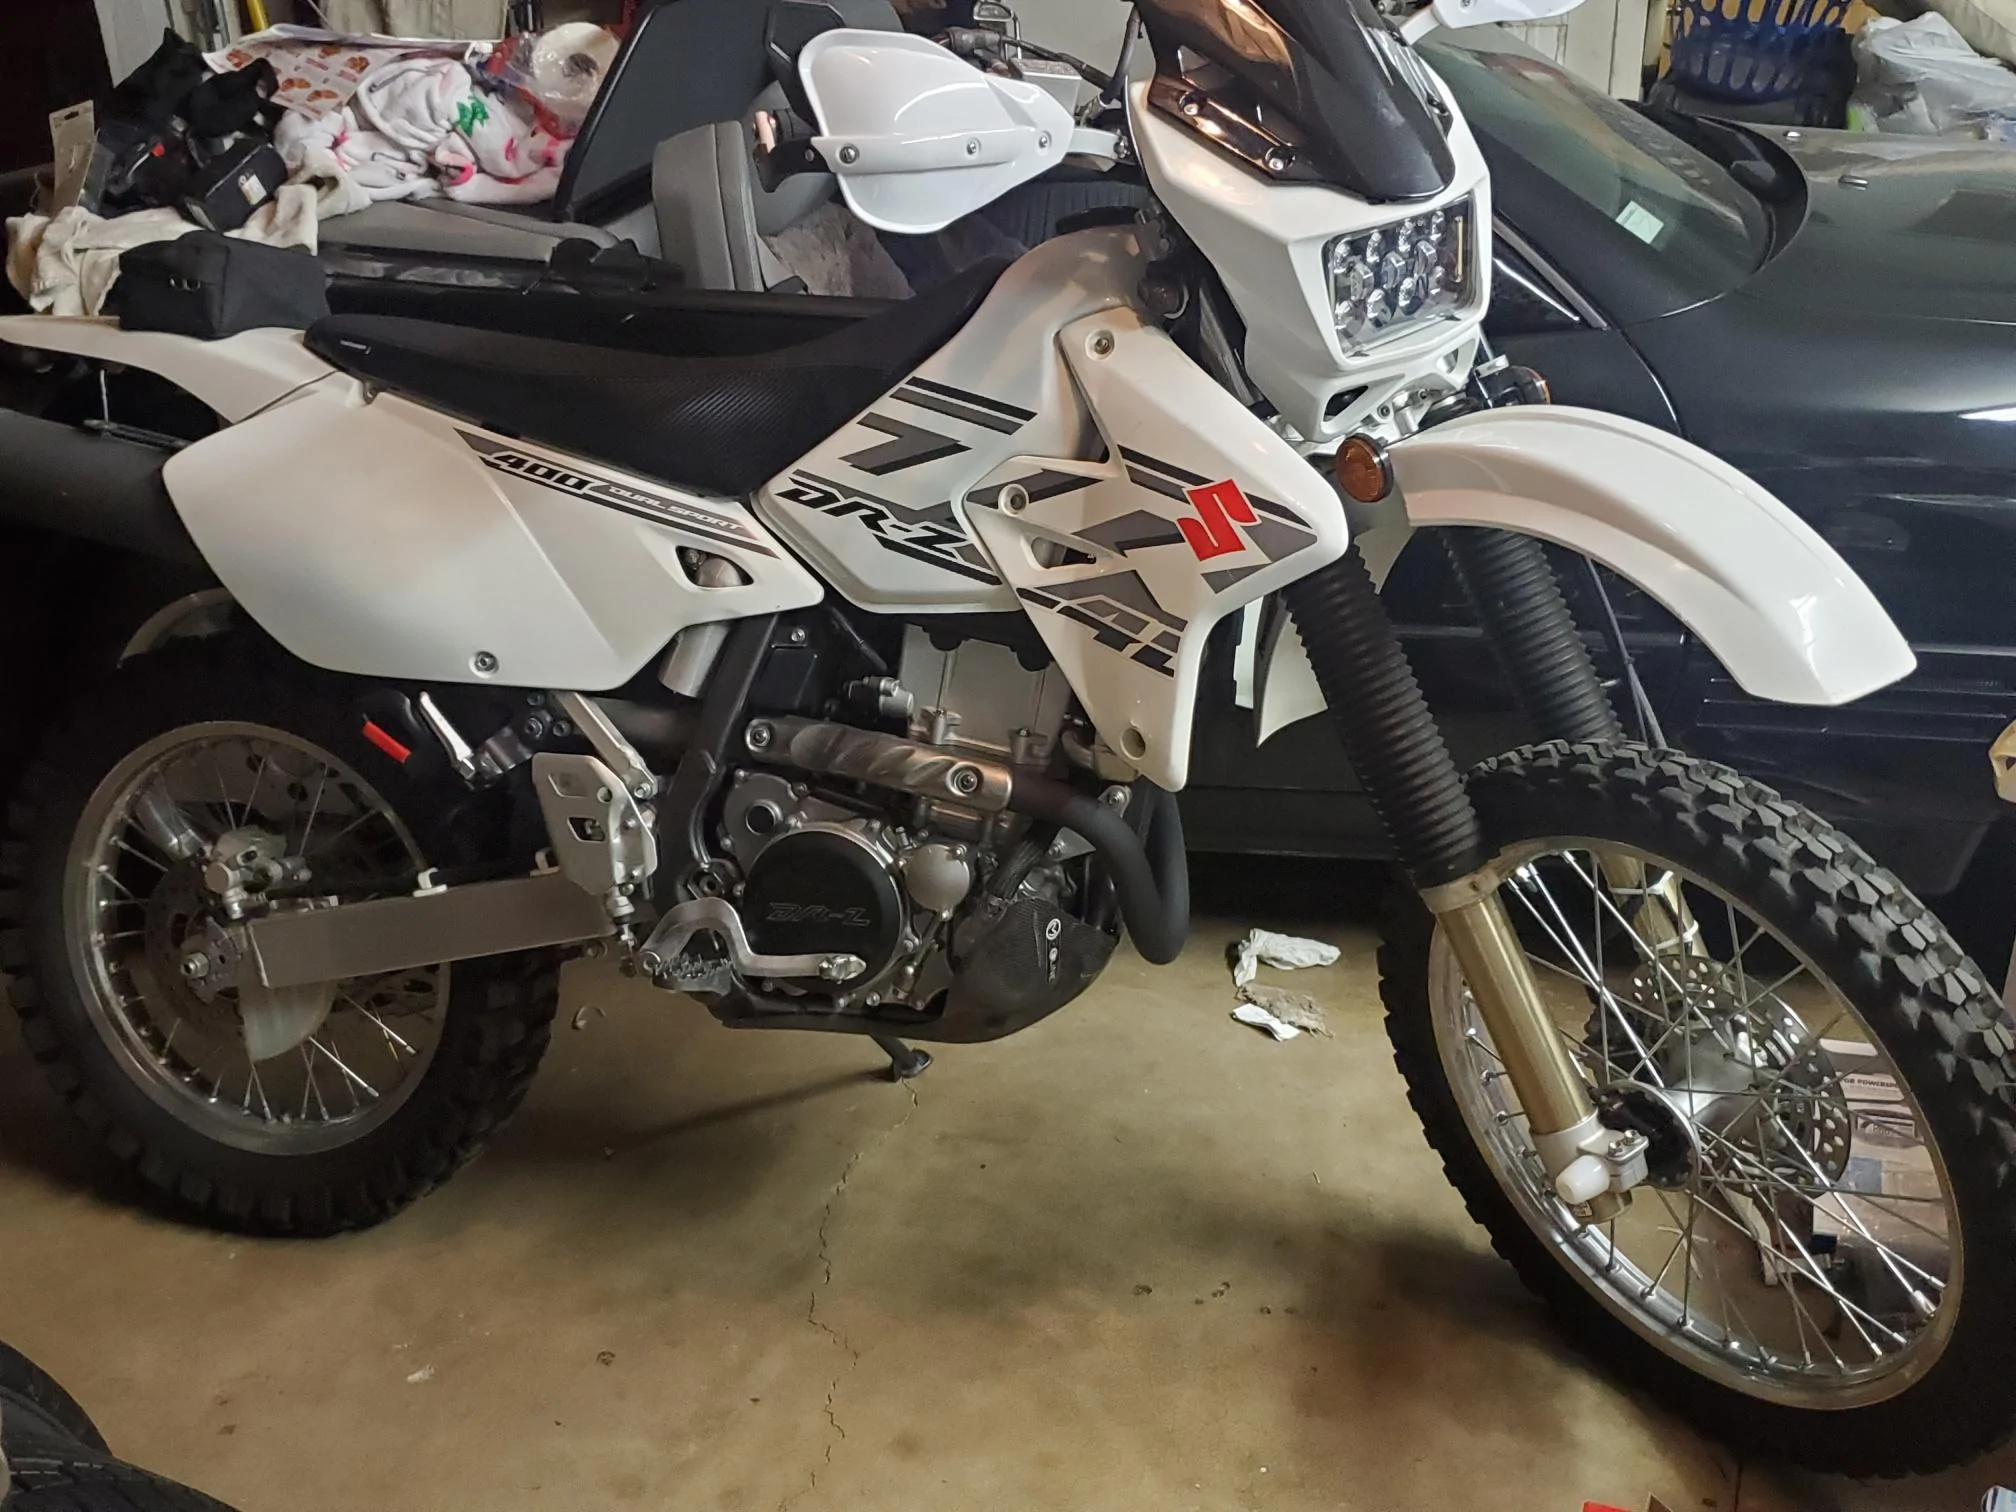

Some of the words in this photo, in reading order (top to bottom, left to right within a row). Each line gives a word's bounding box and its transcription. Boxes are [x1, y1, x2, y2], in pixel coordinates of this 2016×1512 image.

[494, 455, 592, 490] 400
[608, 486, 667, 509] DUAL
[667, 506, 743, 530] SPORT
[774, 477, 968, 559] DR-Z
